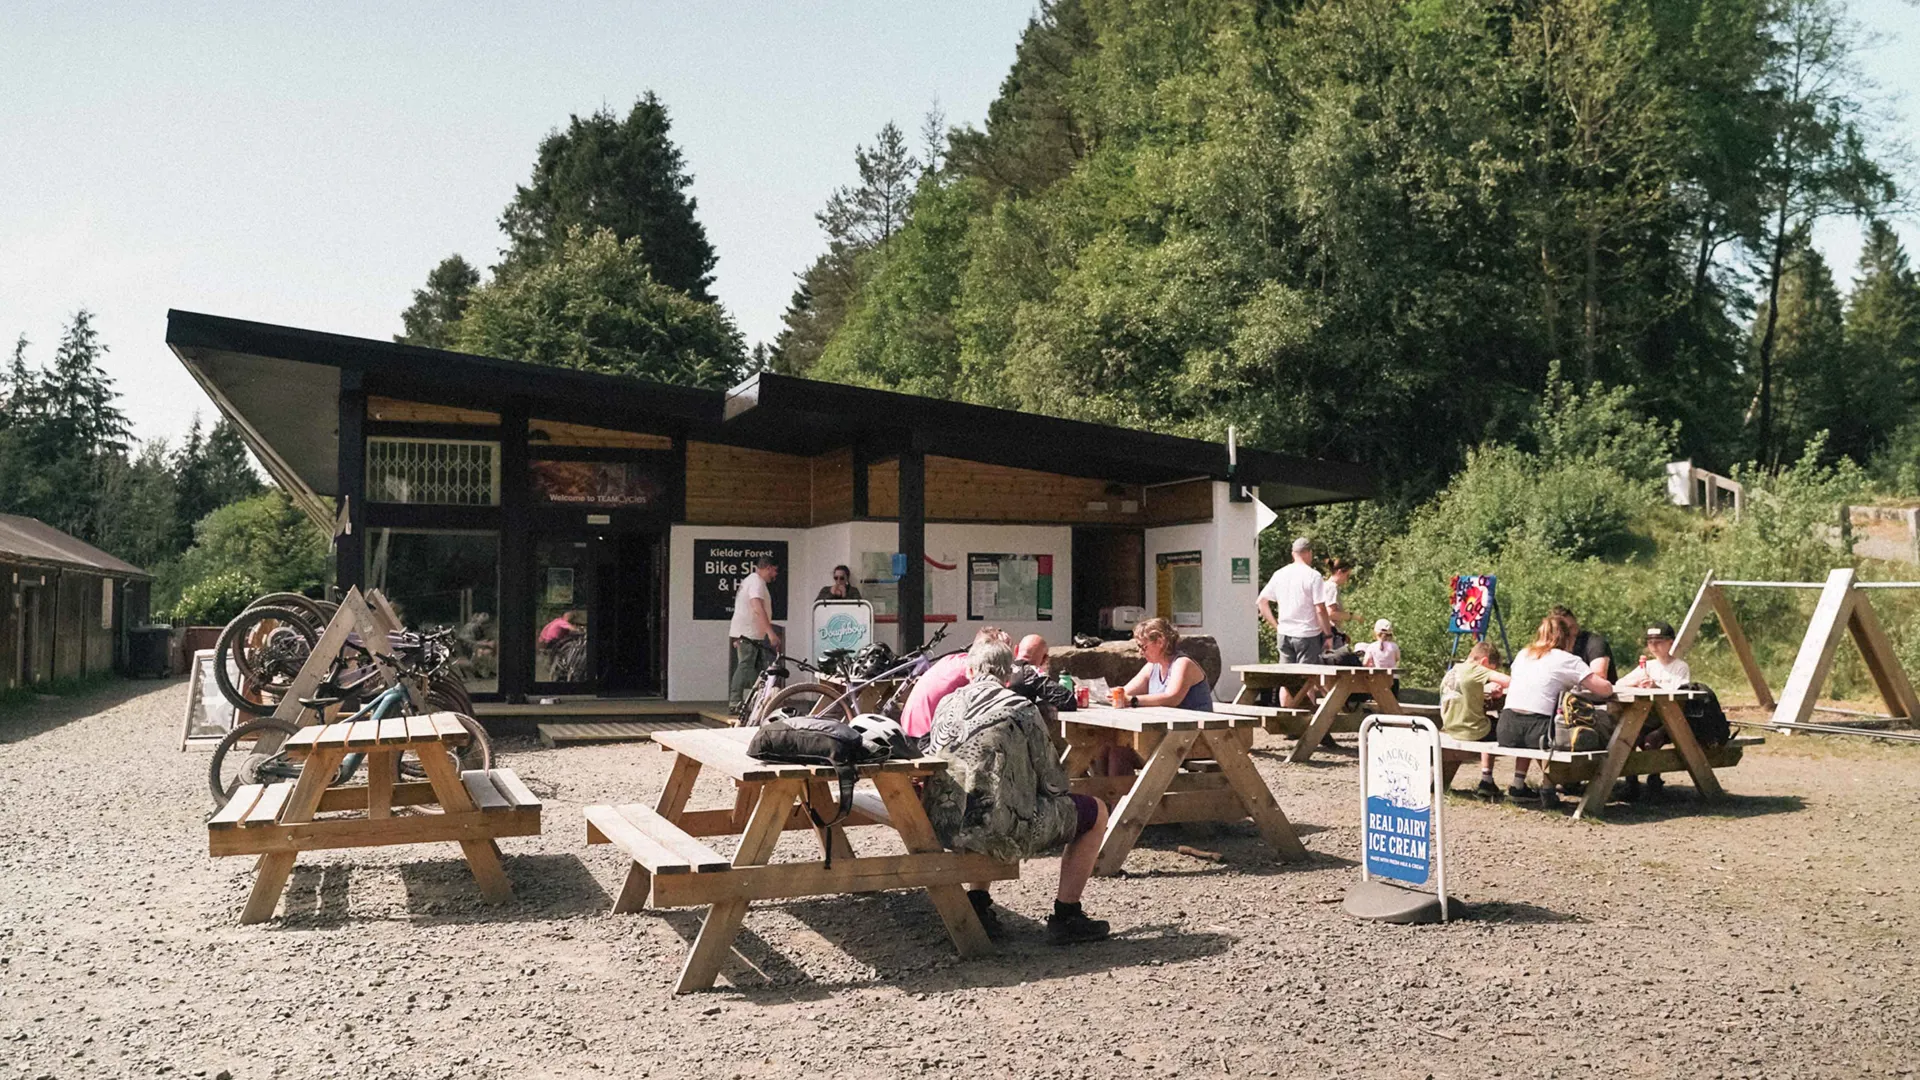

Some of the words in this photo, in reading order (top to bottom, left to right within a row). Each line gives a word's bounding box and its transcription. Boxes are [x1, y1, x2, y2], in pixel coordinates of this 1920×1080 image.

[549, 494, 585, 502] Welcome
[710, 548, 743, 557] Kielder
[705, 561, 737, 574] Bike
[718, 578, 729, 591] &
[817, 621, 867, 642] Doughboys
[1369, 813, 1394, 832] REAL
[1396, 817, 1427, 838] DAIRY
[1369, 832, 1387, 853] ICE
[1388, 836, 1427, 860] CREAM
